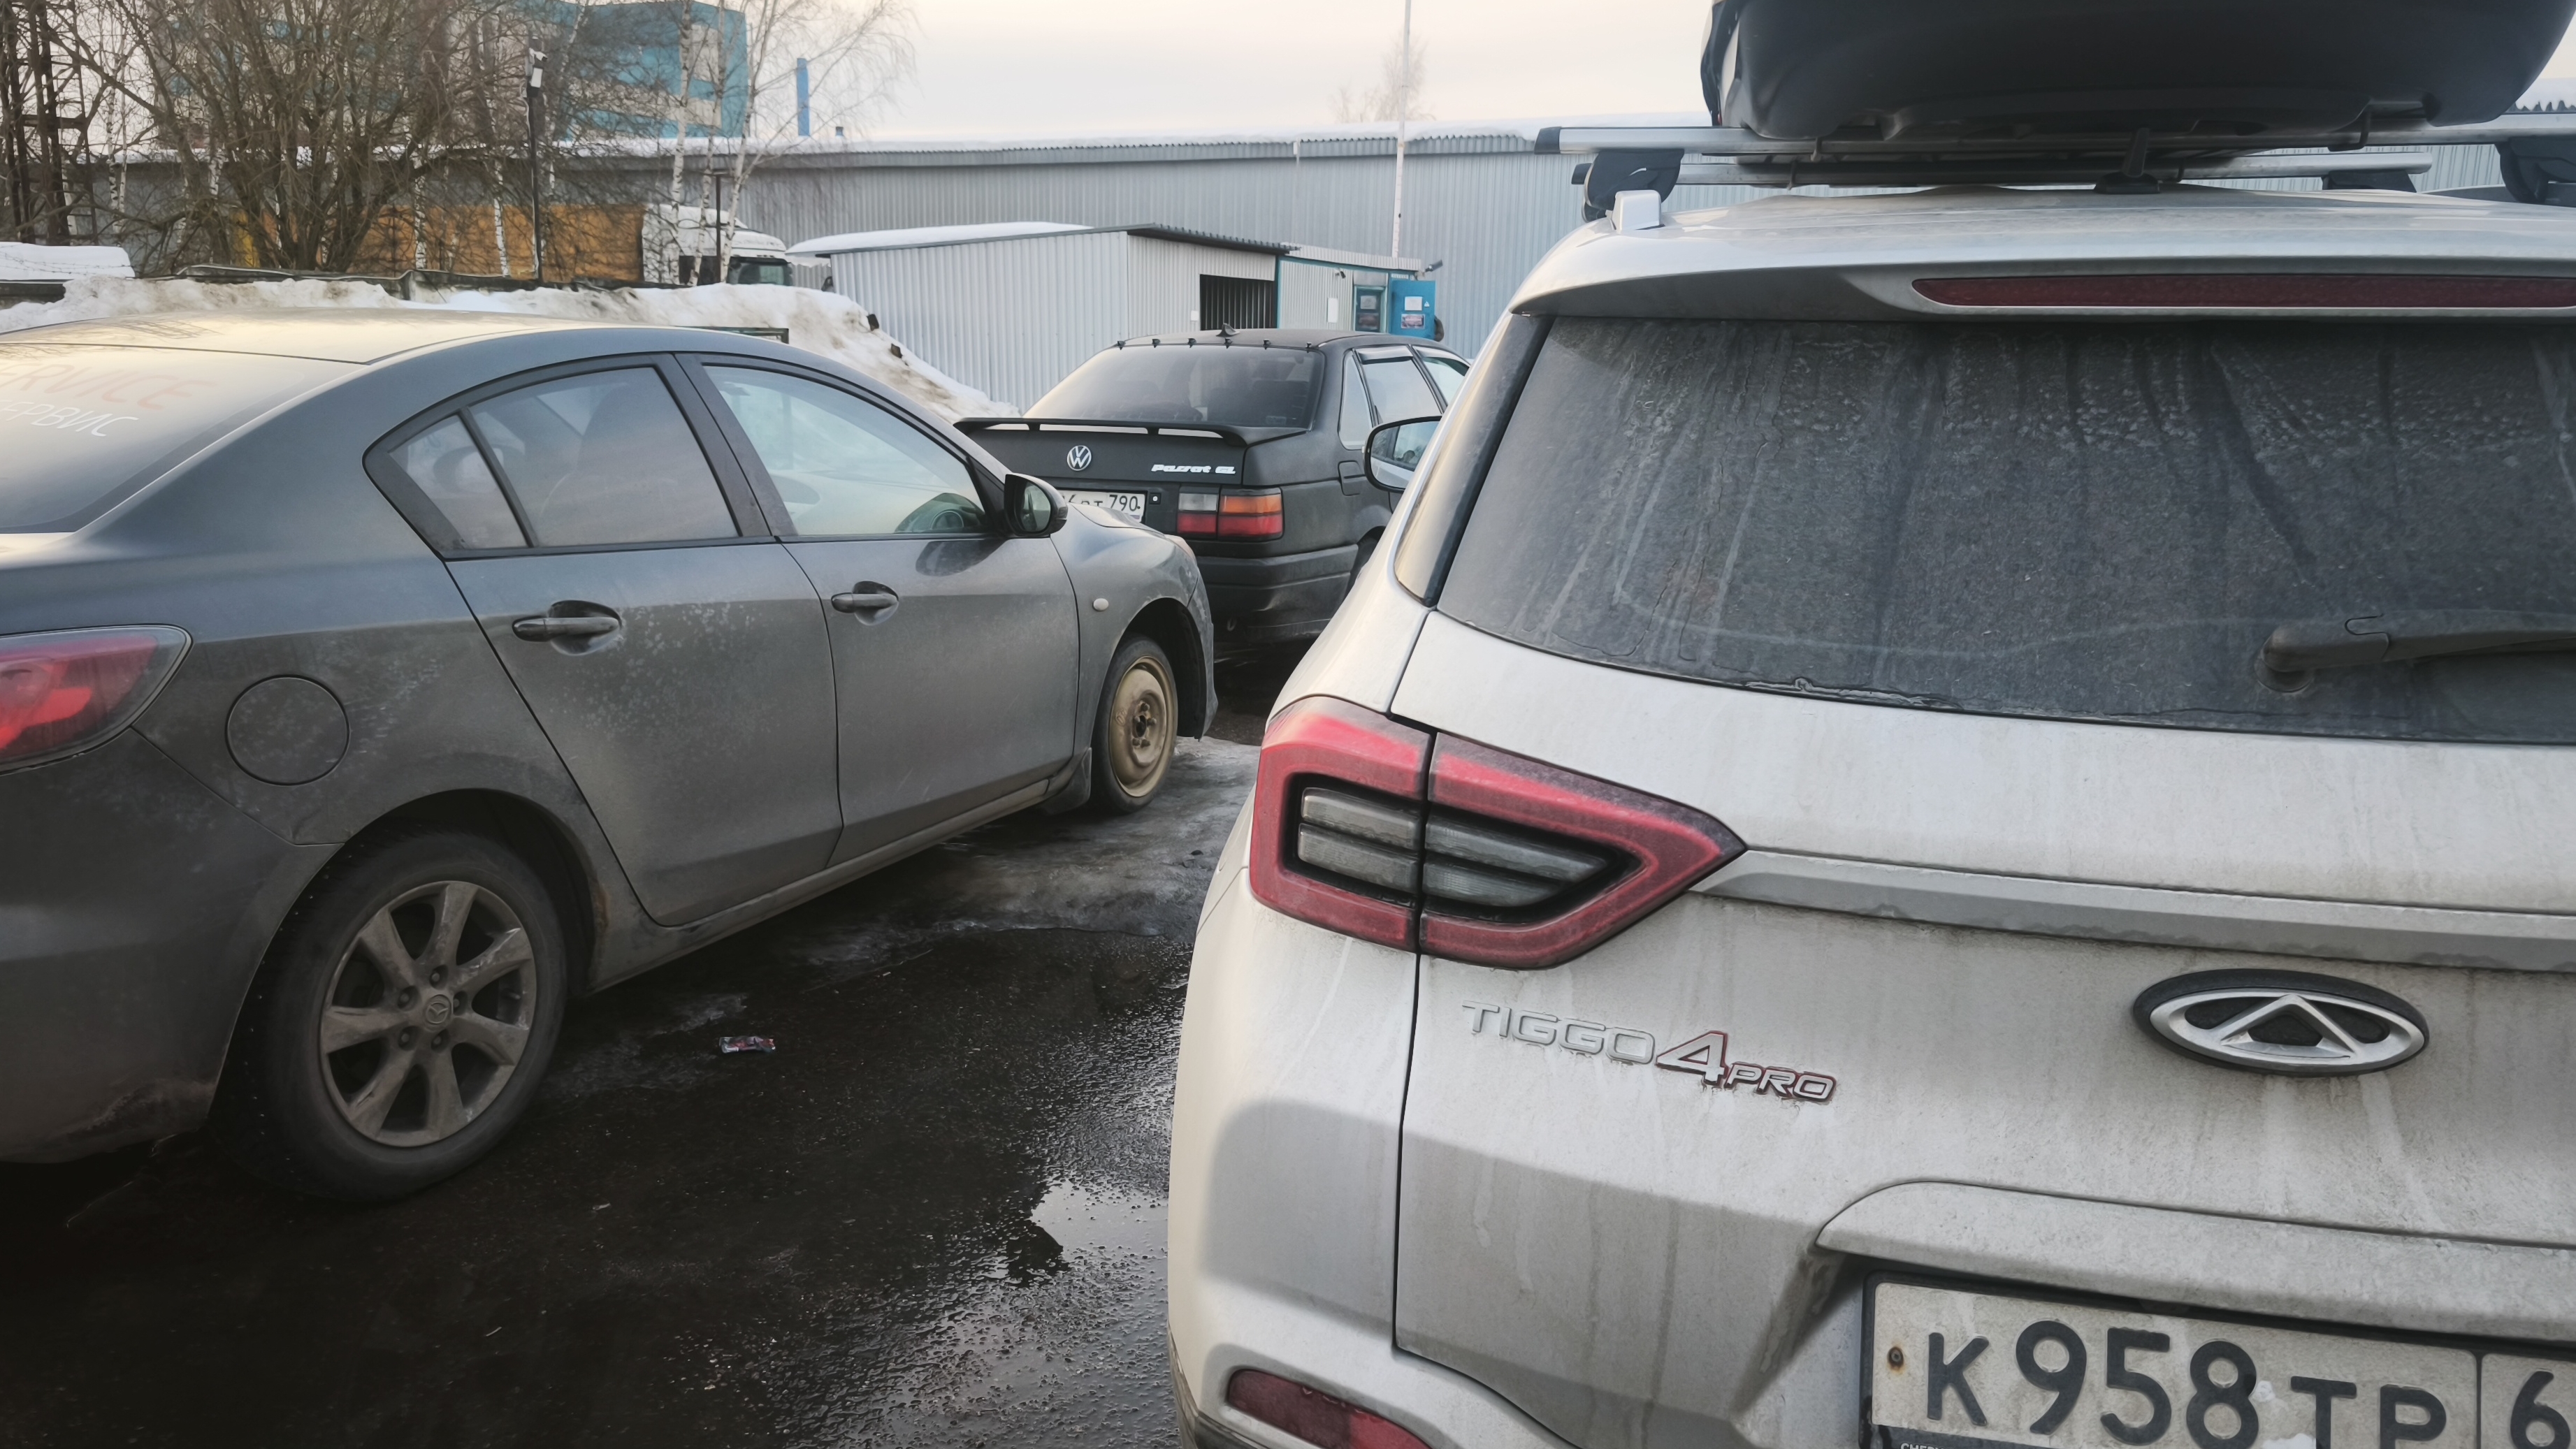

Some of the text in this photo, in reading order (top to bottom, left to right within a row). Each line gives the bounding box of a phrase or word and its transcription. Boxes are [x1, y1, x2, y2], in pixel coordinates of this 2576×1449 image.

[0, 362, 217, 411] ERVICE
[0, 400, 139, 437] ЕРВИС
[1151, 464, 1212, 473] Passat
[1109, 494, 1138, 511] 790
[1462, 1000, 1655, 1065] TIGGO
